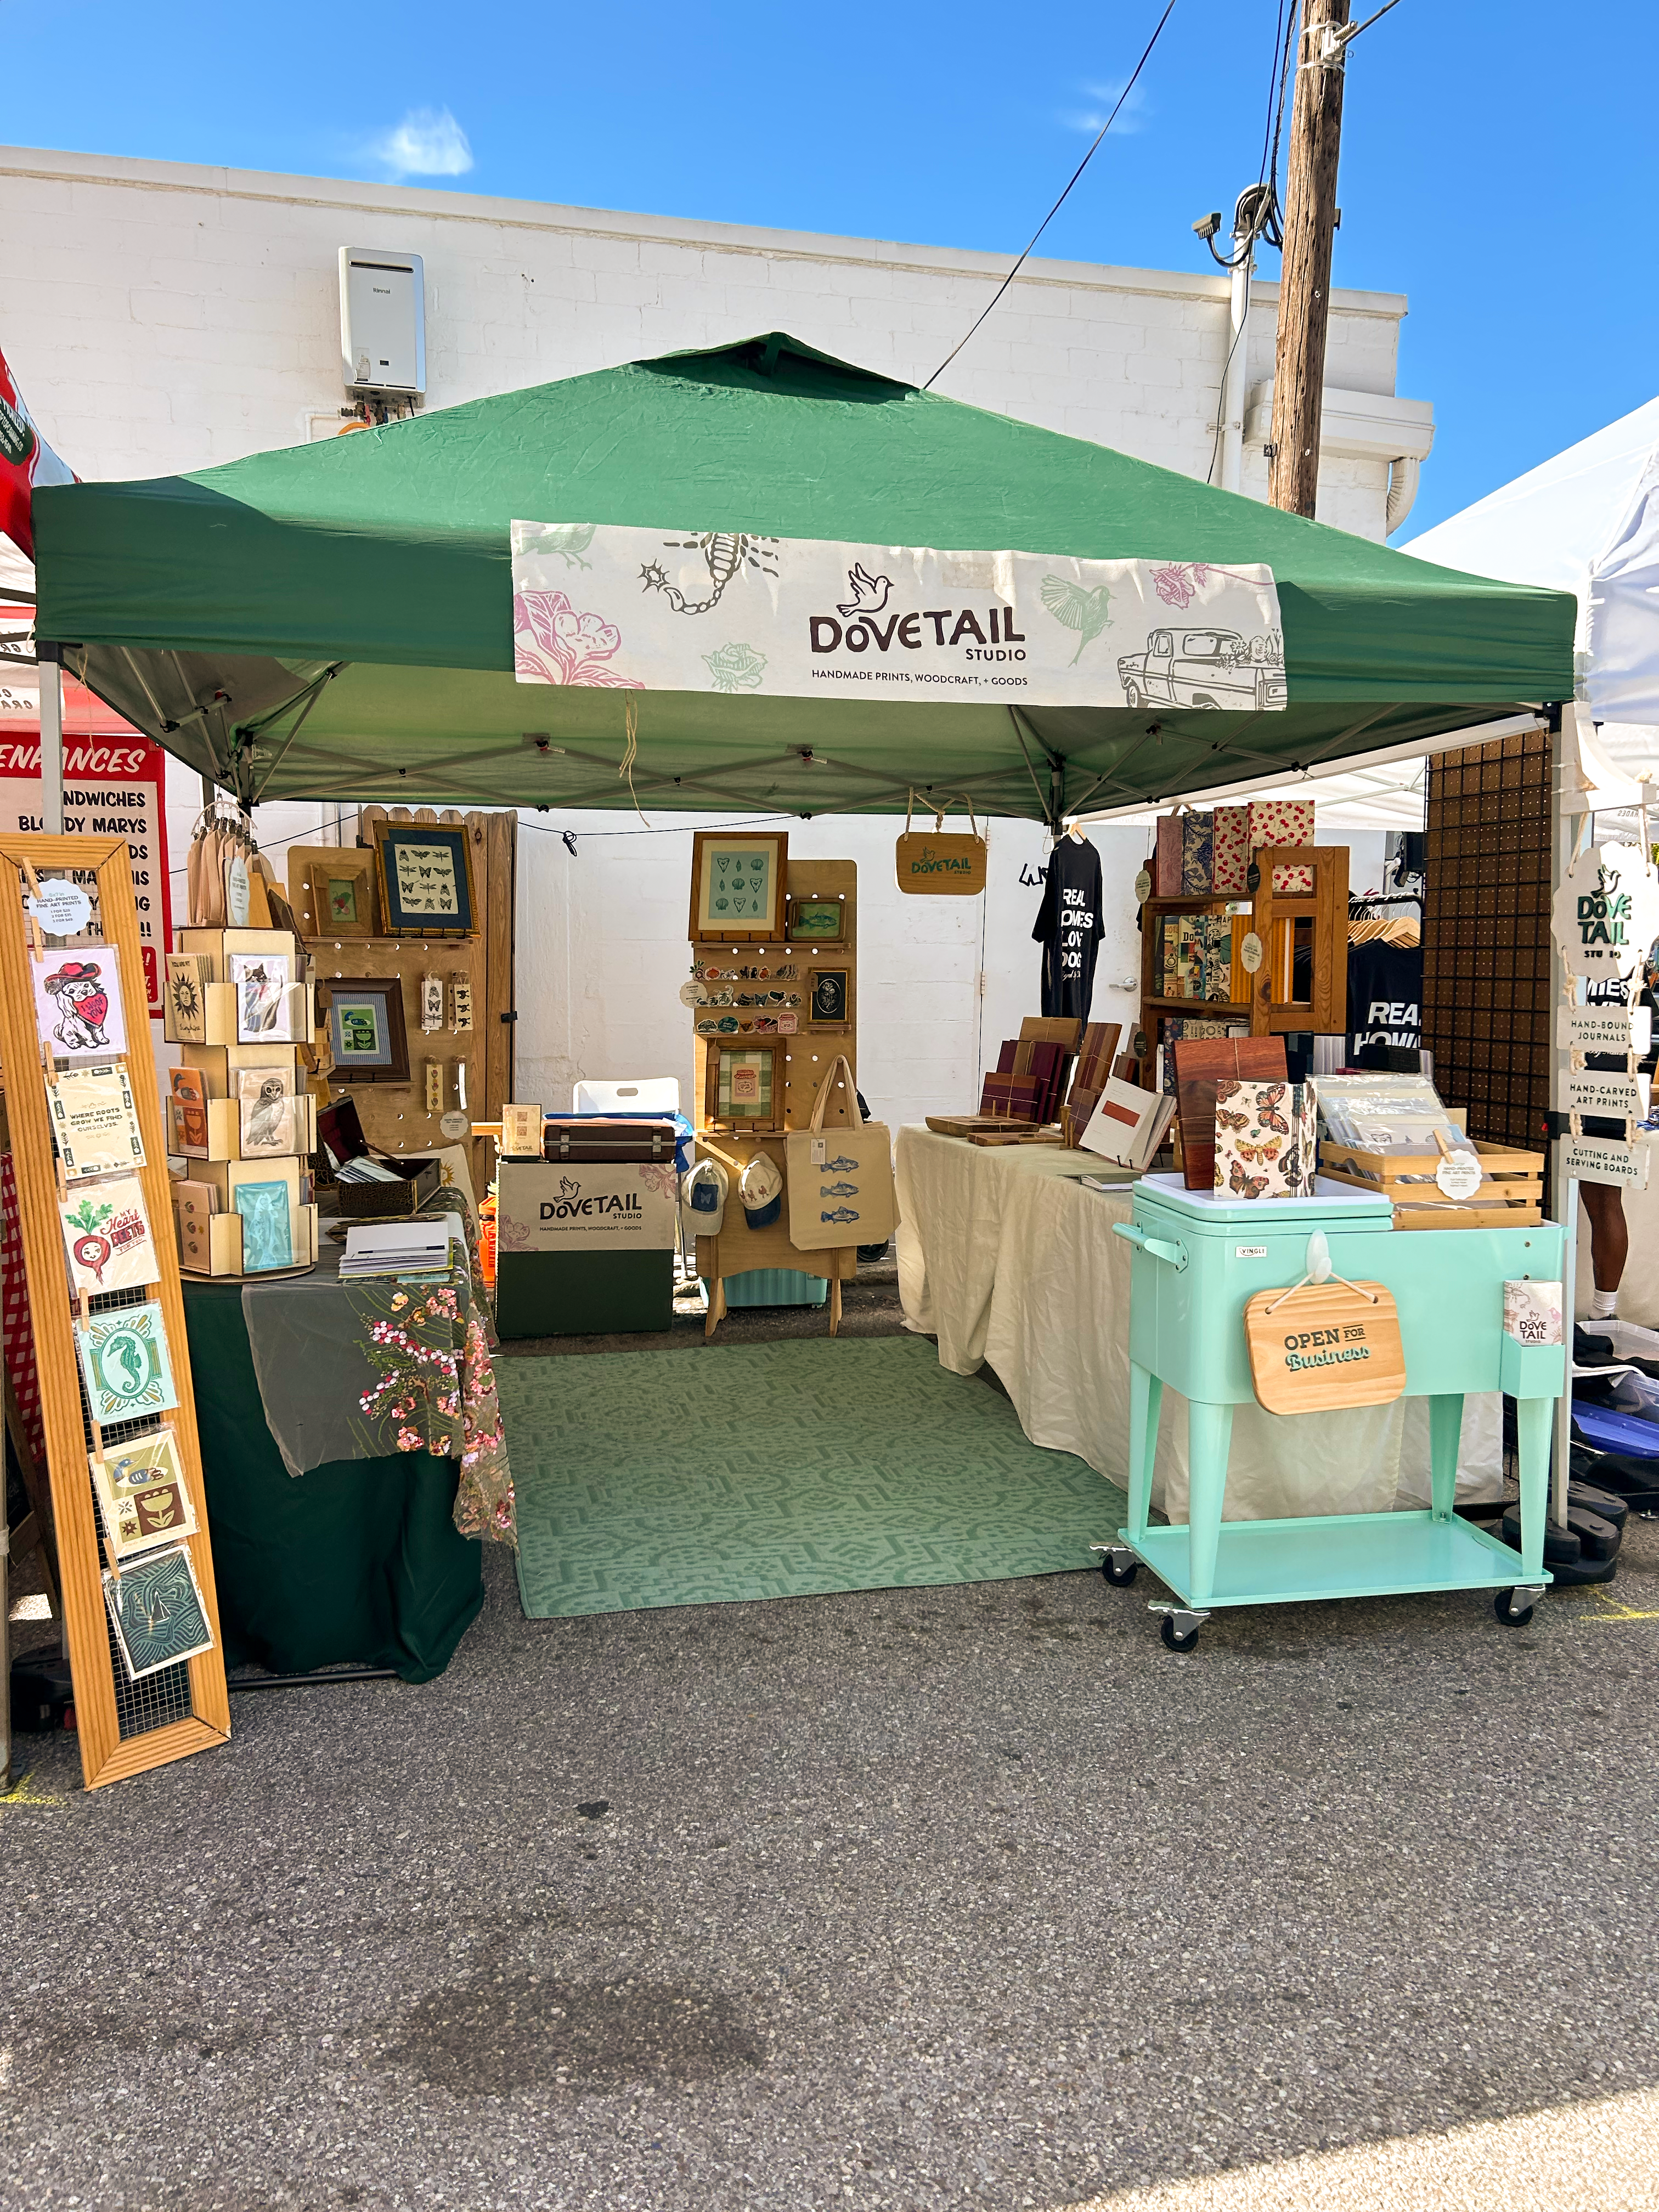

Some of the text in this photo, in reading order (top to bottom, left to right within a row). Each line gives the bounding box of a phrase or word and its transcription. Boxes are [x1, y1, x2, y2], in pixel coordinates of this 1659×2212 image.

[810, 607, 1025, 653] DOVETAIL
[966, 648, 1026, 661] STUDIO
[812, 669, 873, 680] HANDMADE
[876, 672, 913, 683] PRINTS,
[915, 674, 981, 686] WOODCRAFT,
[63, 790, 145, 808] NDWICHES
[18, 816, 147, 833] BLDY MARYS
[912, 857, 971, 873] DOVETAIL
[1577, 893, 1632, 920] DOVE
[1577, 921, 1629, 946] TAIL
[87, 1006, 103, 1019] YOU
[1368, 1002, 1421, 1026] REA
[1571, 1020, 1634, 1030] HAND-BOUND
[1578, 1032, 1626, 1042] JOURNALS
[1570, 1084, 1637, 1097] HAND-CARVED
[1576, 1096, 1629, 1108] ART PRINTS
[96, 1107, 120, 1115] ROOTS
[1573, 1148, 1629, 1163] CUTTING AND
[1566, 1157, 1638, 1176] SERVING BOARDS
[120, 1209, 131, 1217] MY
[540, 1193, 642, 1220] DOVETAIL
[100, 1209, 140, 1235] Heart
[110, 1221, 145, 1248] BEETS
[1520, 1321, 1547, 1330] DOVE
[1284, 1328, 1365, 1350] OPEN FOR
[1520, 1330, 1545, 1339] TAIL
[1285, 1346, 1370, 1372] Business
